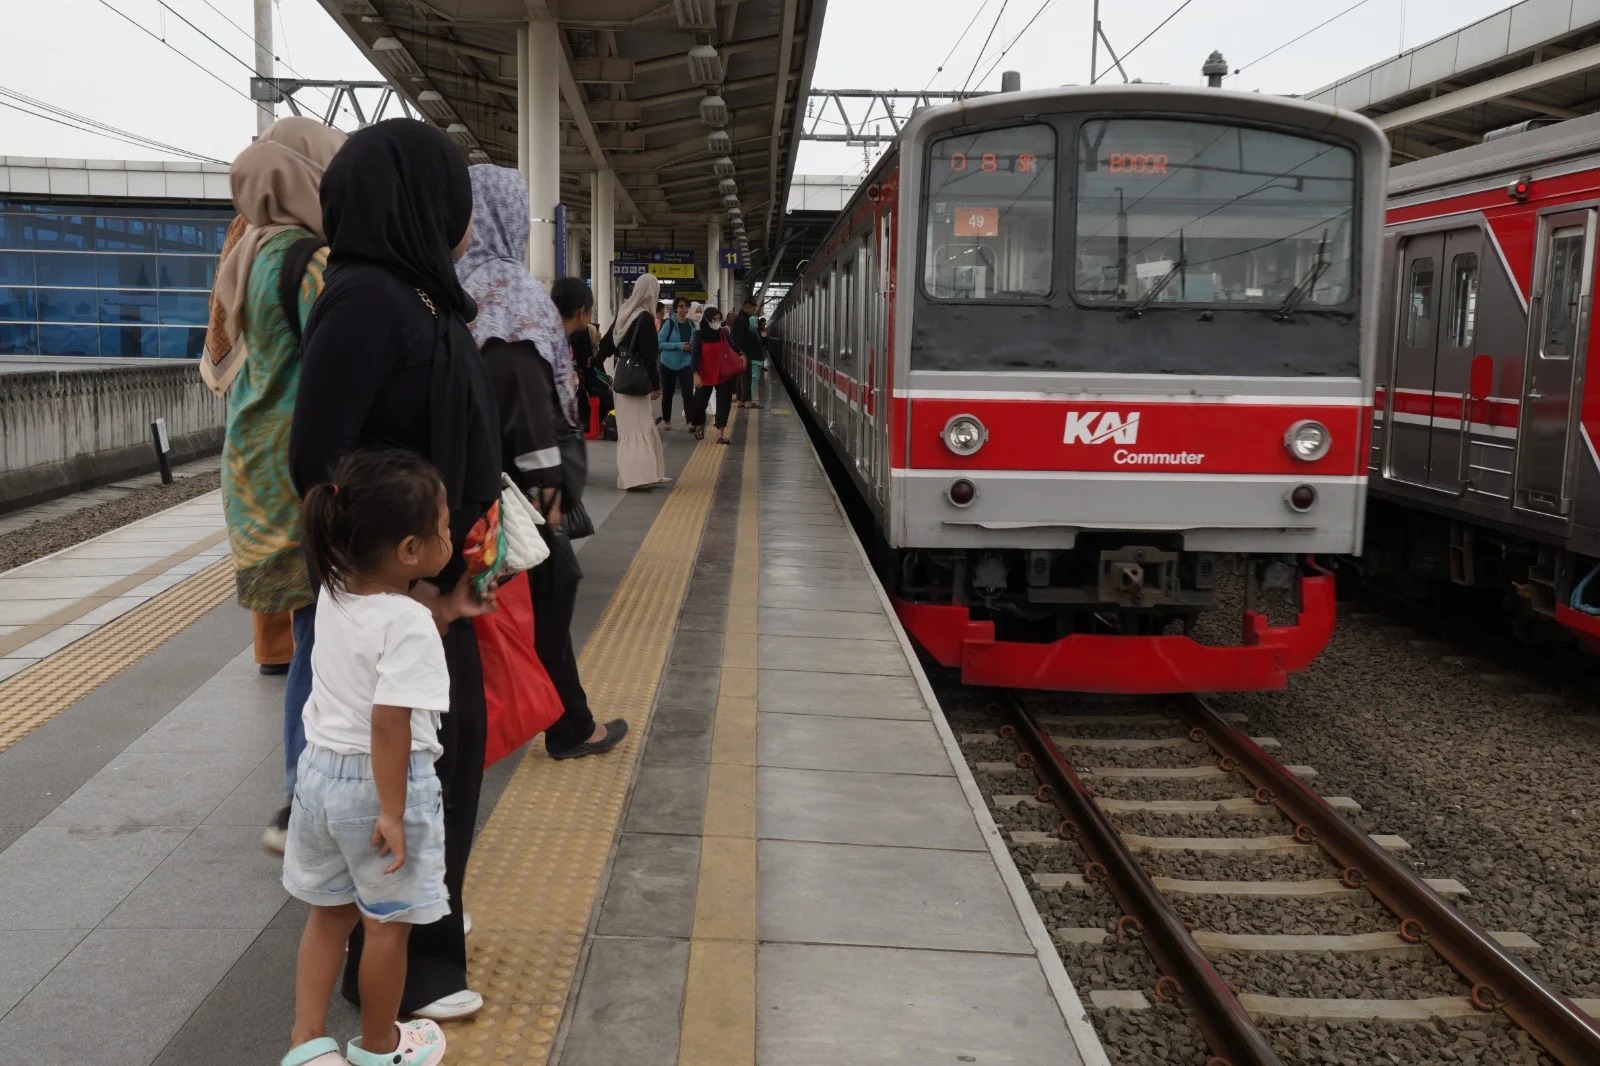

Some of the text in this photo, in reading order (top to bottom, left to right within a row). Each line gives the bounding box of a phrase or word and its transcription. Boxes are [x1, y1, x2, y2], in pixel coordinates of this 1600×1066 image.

[1110, 153, 1169, 174] BOGOR
[968, 214, 984, 228] 49
[725, 252, 738, 265] 11
[1063, 411, 1140, 445] KAI
[1113, 449, 1205, 465] Commuter
